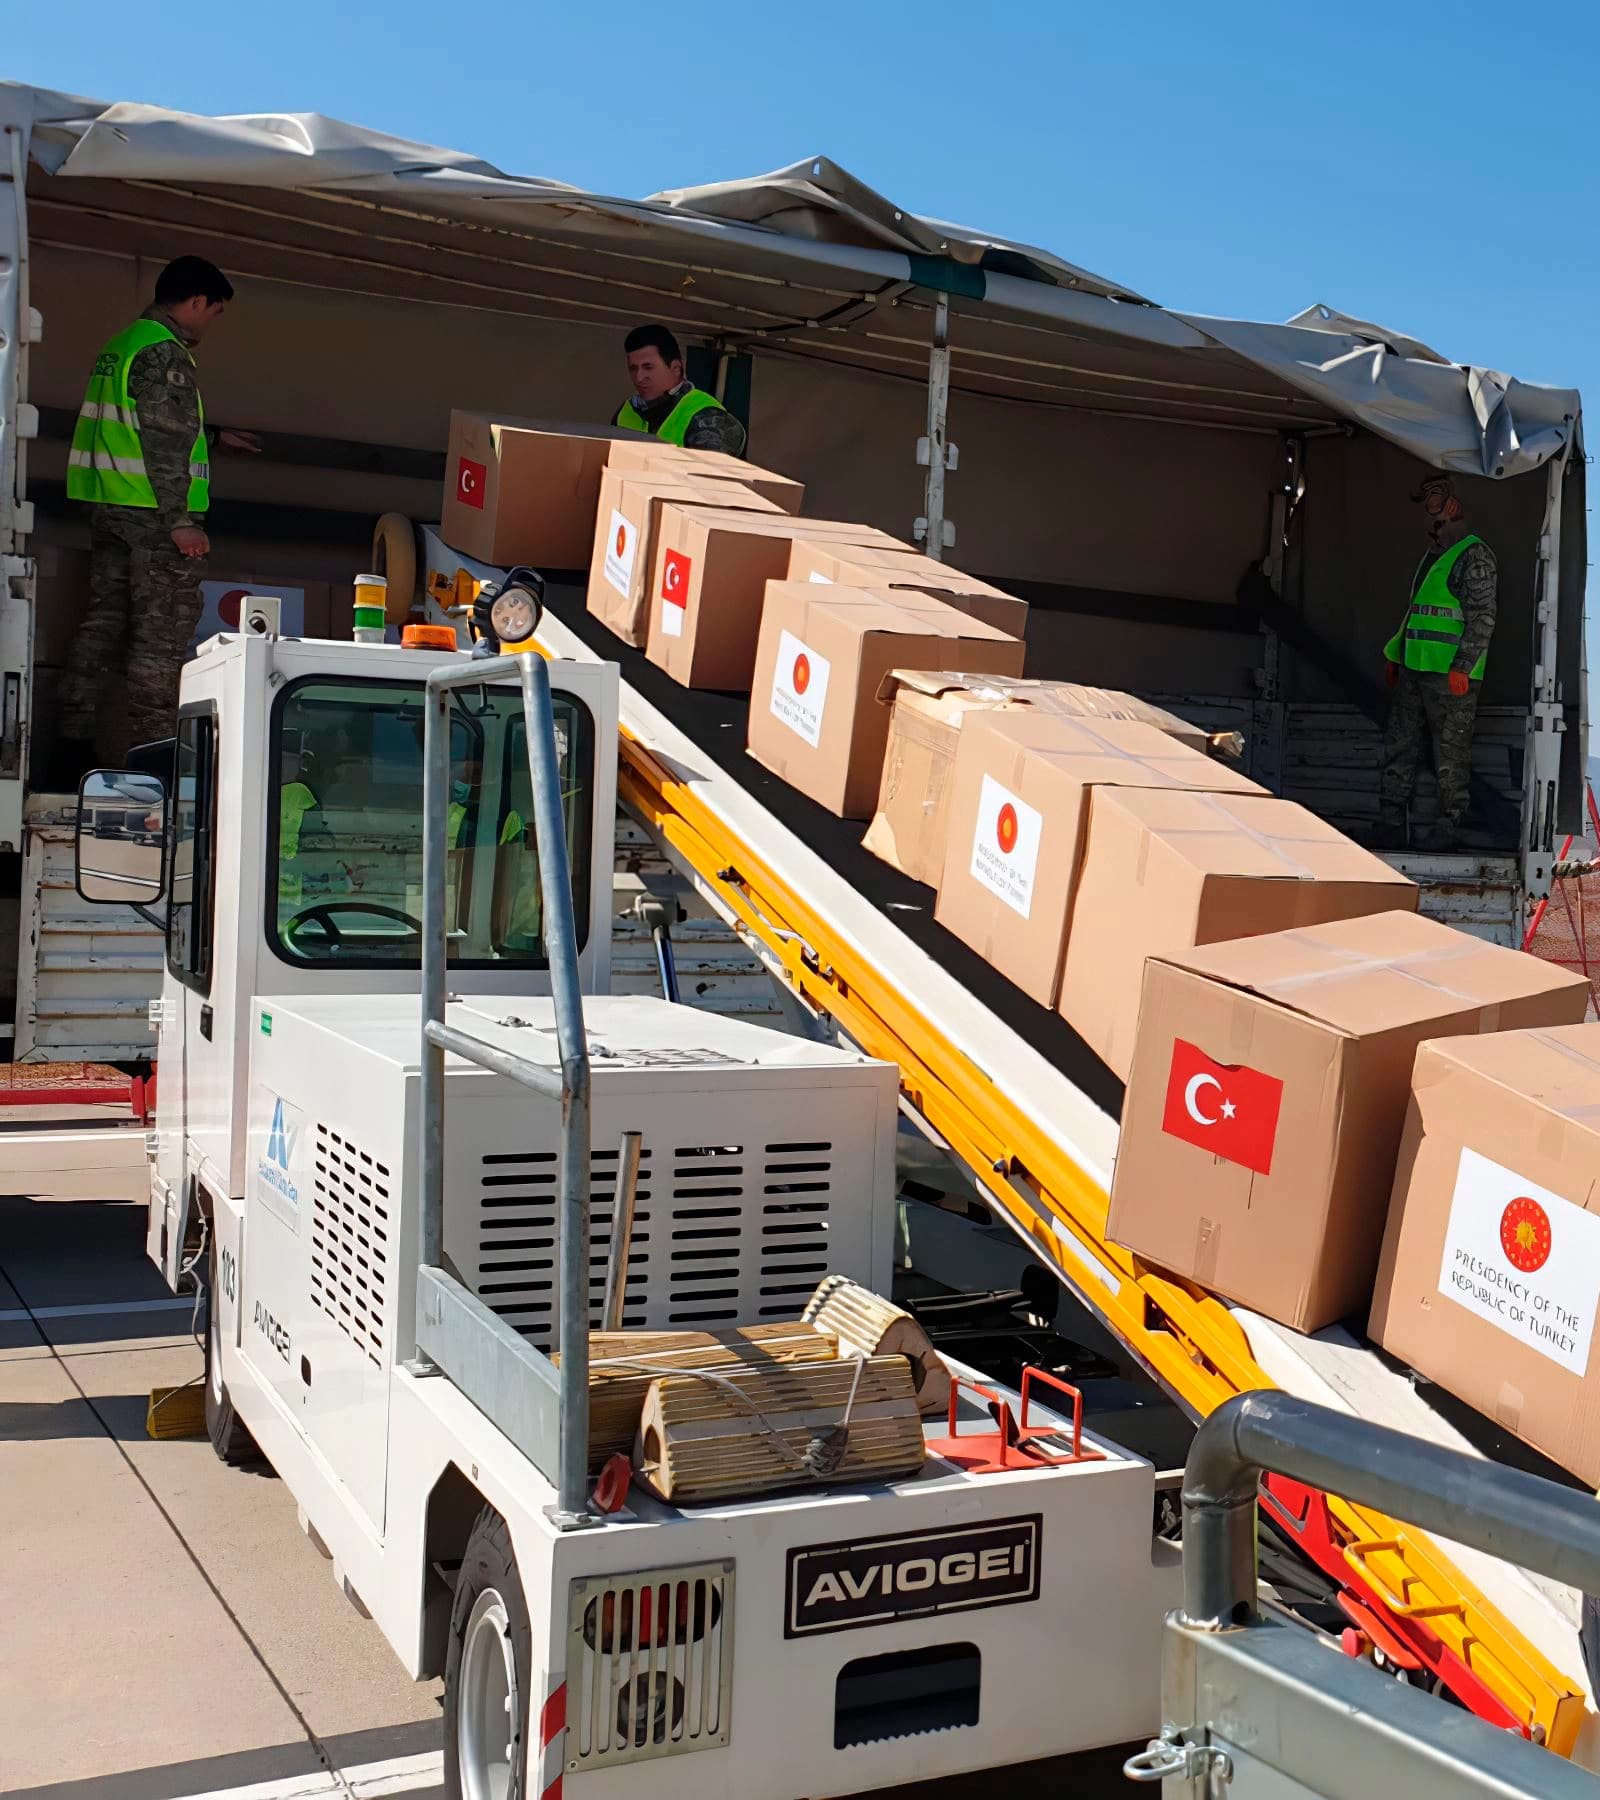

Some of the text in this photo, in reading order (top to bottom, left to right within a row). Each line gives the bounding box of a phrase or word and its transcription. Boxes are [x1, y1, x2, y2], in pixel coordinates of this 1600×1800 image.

[1451, 1270, 1507, 1315] REPUBLIC
[1529, 1315, 1576, 1353] TURKEY
[1455, 1249, 1580, 1332] PRESIDENCY OF THE
[804, 1544, 1025, 1607] AVIOGEI
